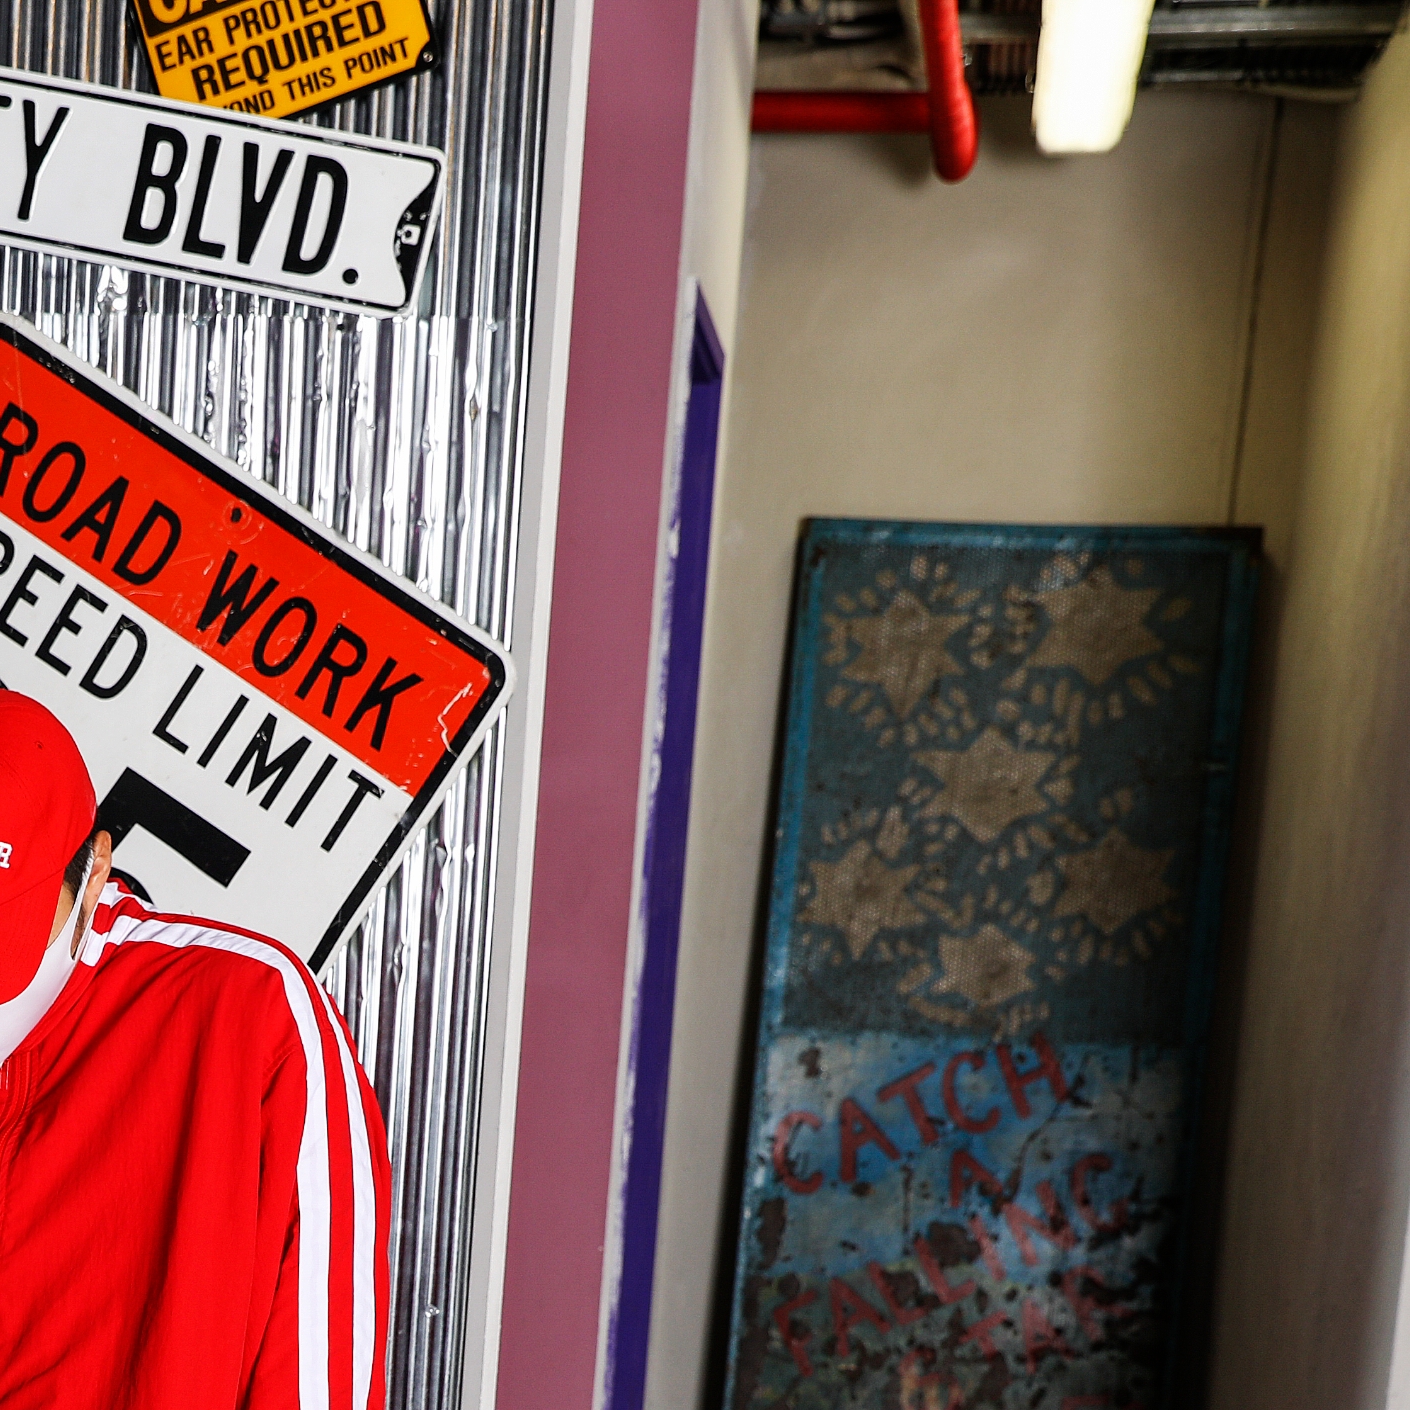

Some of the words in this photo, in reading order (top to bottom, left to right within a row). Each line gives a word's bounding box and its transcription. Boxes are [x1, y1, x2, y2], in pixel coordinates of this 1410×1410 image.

[155, 26, 214, 73] EAR
[191, 1, 386, 101] REQUIRED
[283, 67, 336, 101] THIS
[344, 37, 410, 81] POINT
[122, 123, 359, 285] BLVD.
[196, 549, 426, 752] WORK
[153, 665, 386, 852] LIMIT
[774, 1031, 1068, 1195] CATCH
[949, 1149, 1004, 1208] A
[774, 1153, 1129, 1377] FALLING
